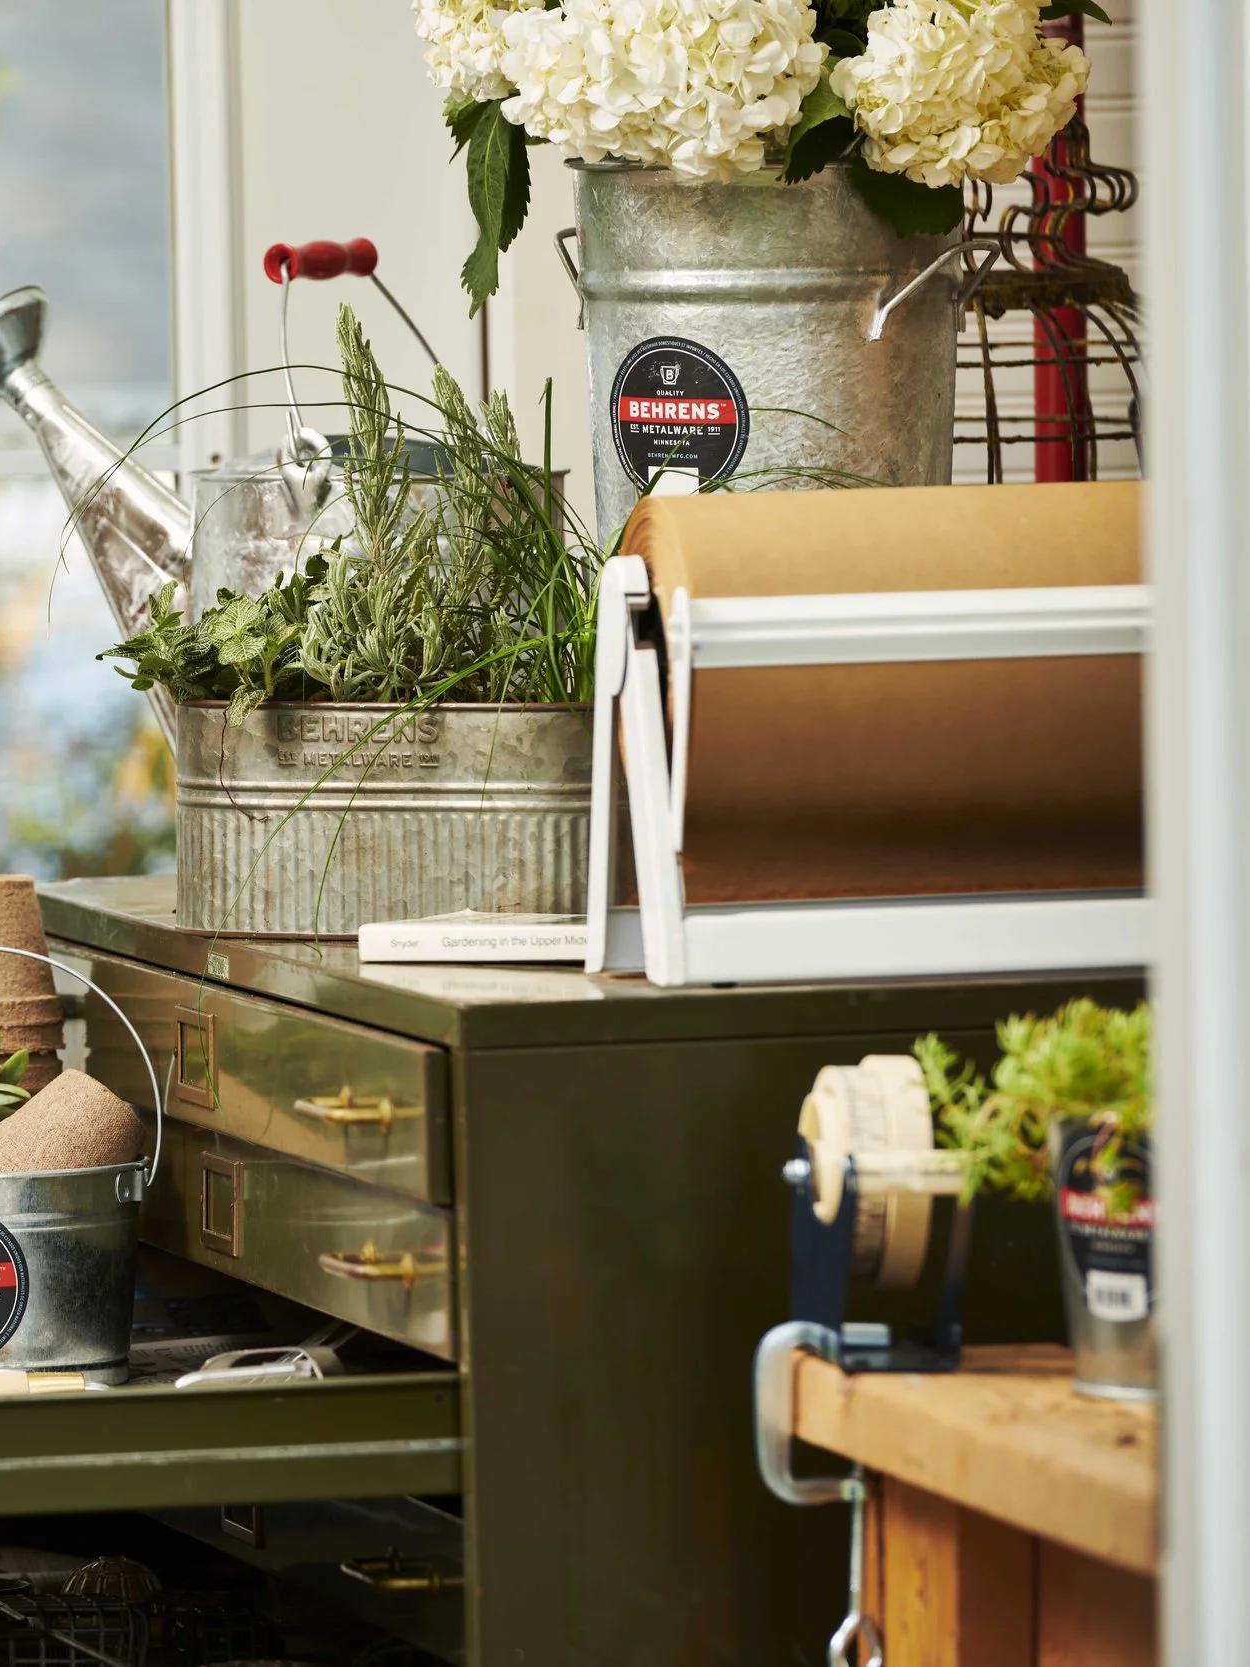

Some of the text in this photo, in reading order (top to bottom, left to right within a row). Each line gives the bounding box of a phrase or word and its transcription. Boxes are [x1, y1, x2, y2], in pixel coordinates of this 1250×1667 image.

[629, 400, 720, 420] BEHRENS
[642, 425, 704, 435] METALWARE
[278, 714, 440, 744] BEHRENS
[303, 751, 412, 768] METALWARE
[390, 939, 420, 949] Snyder
[442, 936, 497, 949] Gardening
[500, 936, 509, 946] in
[511, 936, 527, 946] the
[530, 936, 562, 948] Upper
